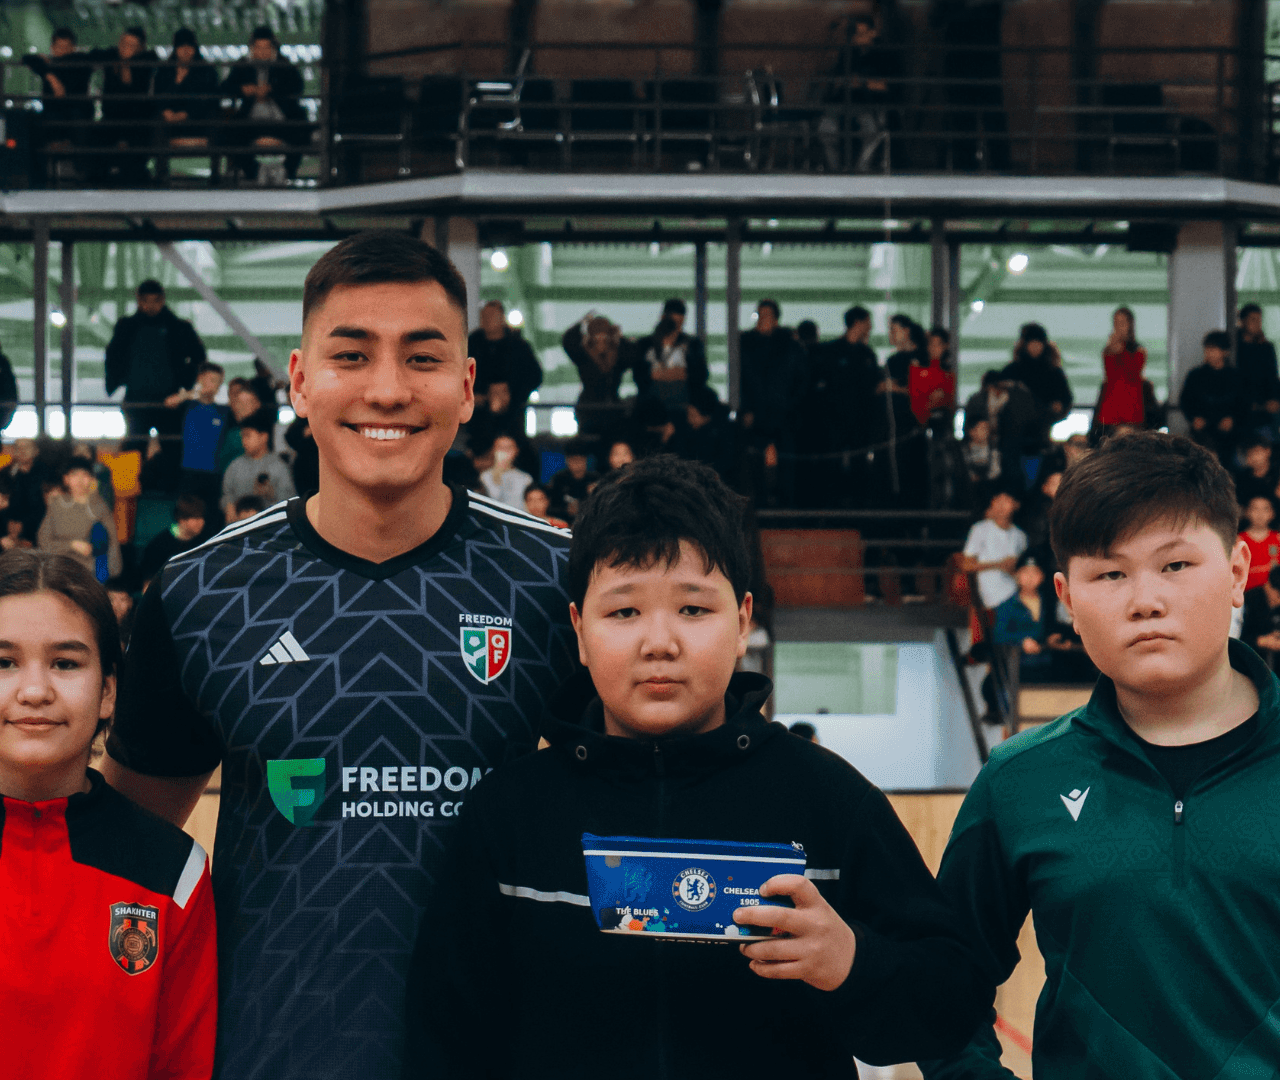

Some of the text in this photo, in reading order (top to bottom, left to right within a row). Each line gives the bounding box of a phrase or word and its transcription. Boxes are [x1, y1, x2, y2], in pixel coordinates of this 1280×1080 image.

[459, 613, 513, 627] FREEDOM
[342, 801, 435, 818] HOLDING
[723, 886, 760, 895] CHELSEA
[740, 898, 760, 906] 1905
[115, 906, 157, 920] SHAKHTER
[634, 908, 659, 917] BLUES
